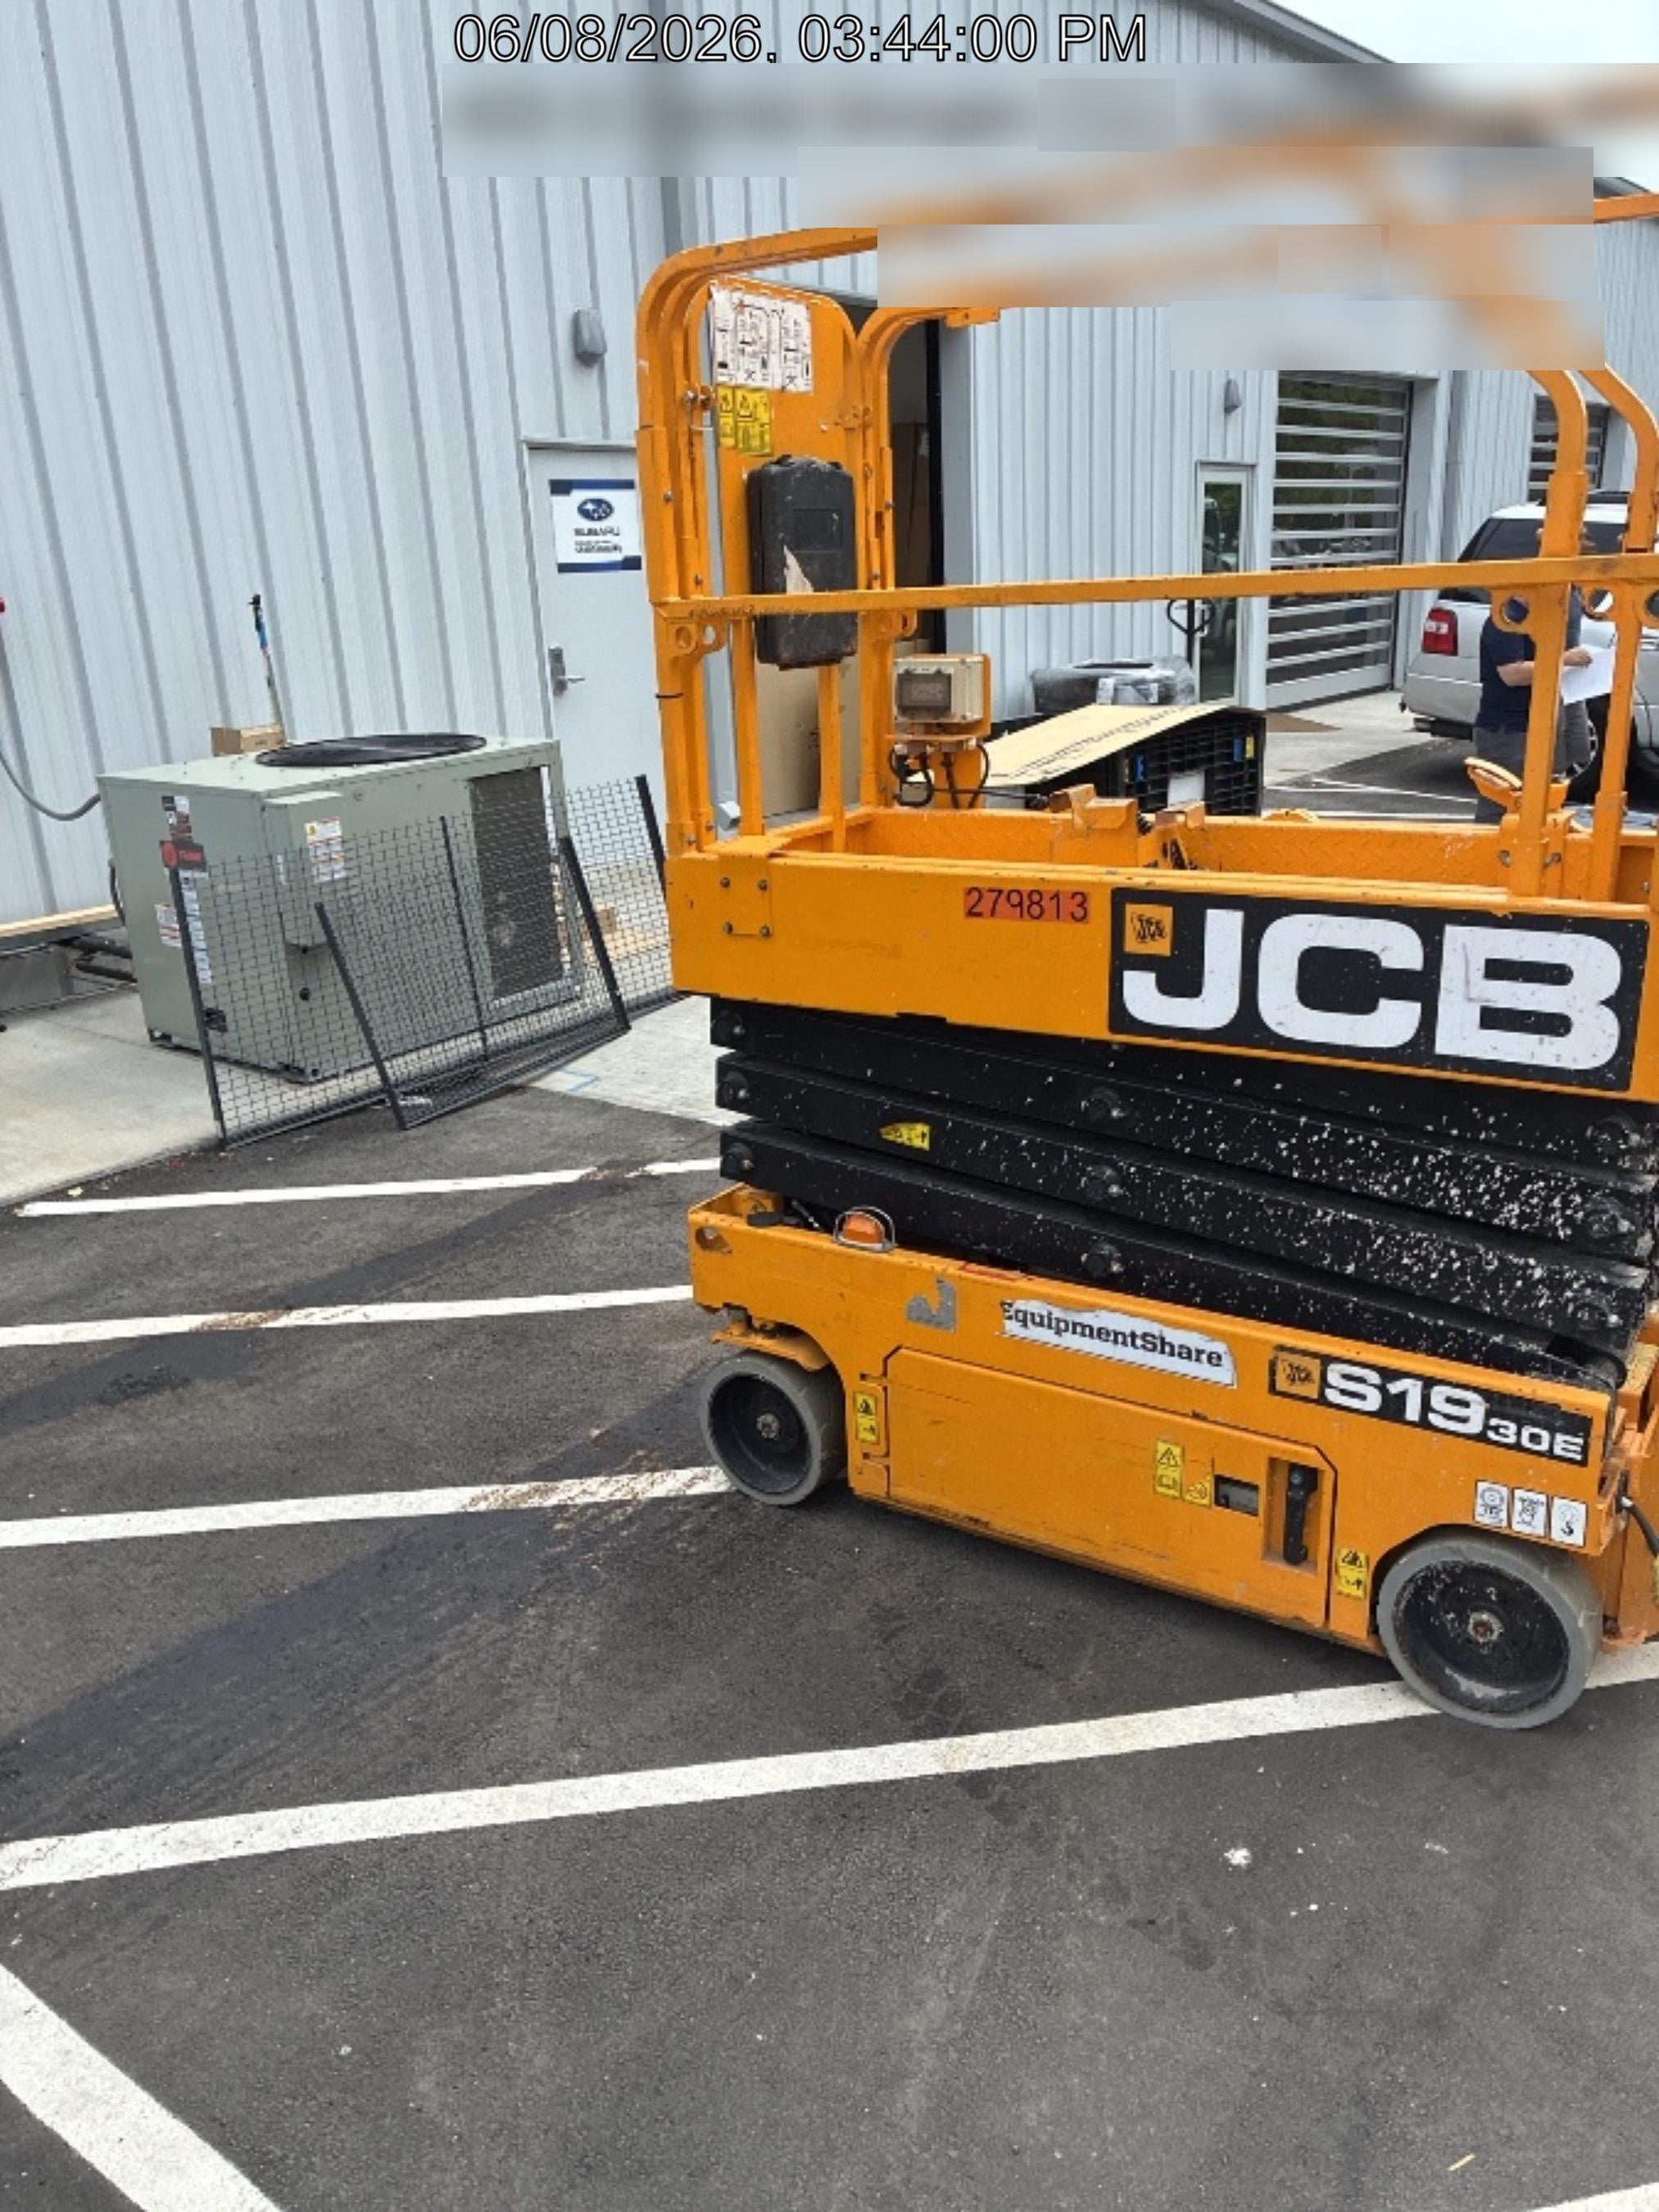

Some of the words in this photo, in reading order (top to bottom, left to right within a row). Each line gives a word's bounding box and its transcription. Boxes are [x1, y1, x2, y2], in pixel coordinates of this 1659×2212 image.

[965, 886, 1089, 922] 279813
[1122, 909, 1621, 1070] JCB
[1000, 1300, 1223, 1367] EquipmentShare
